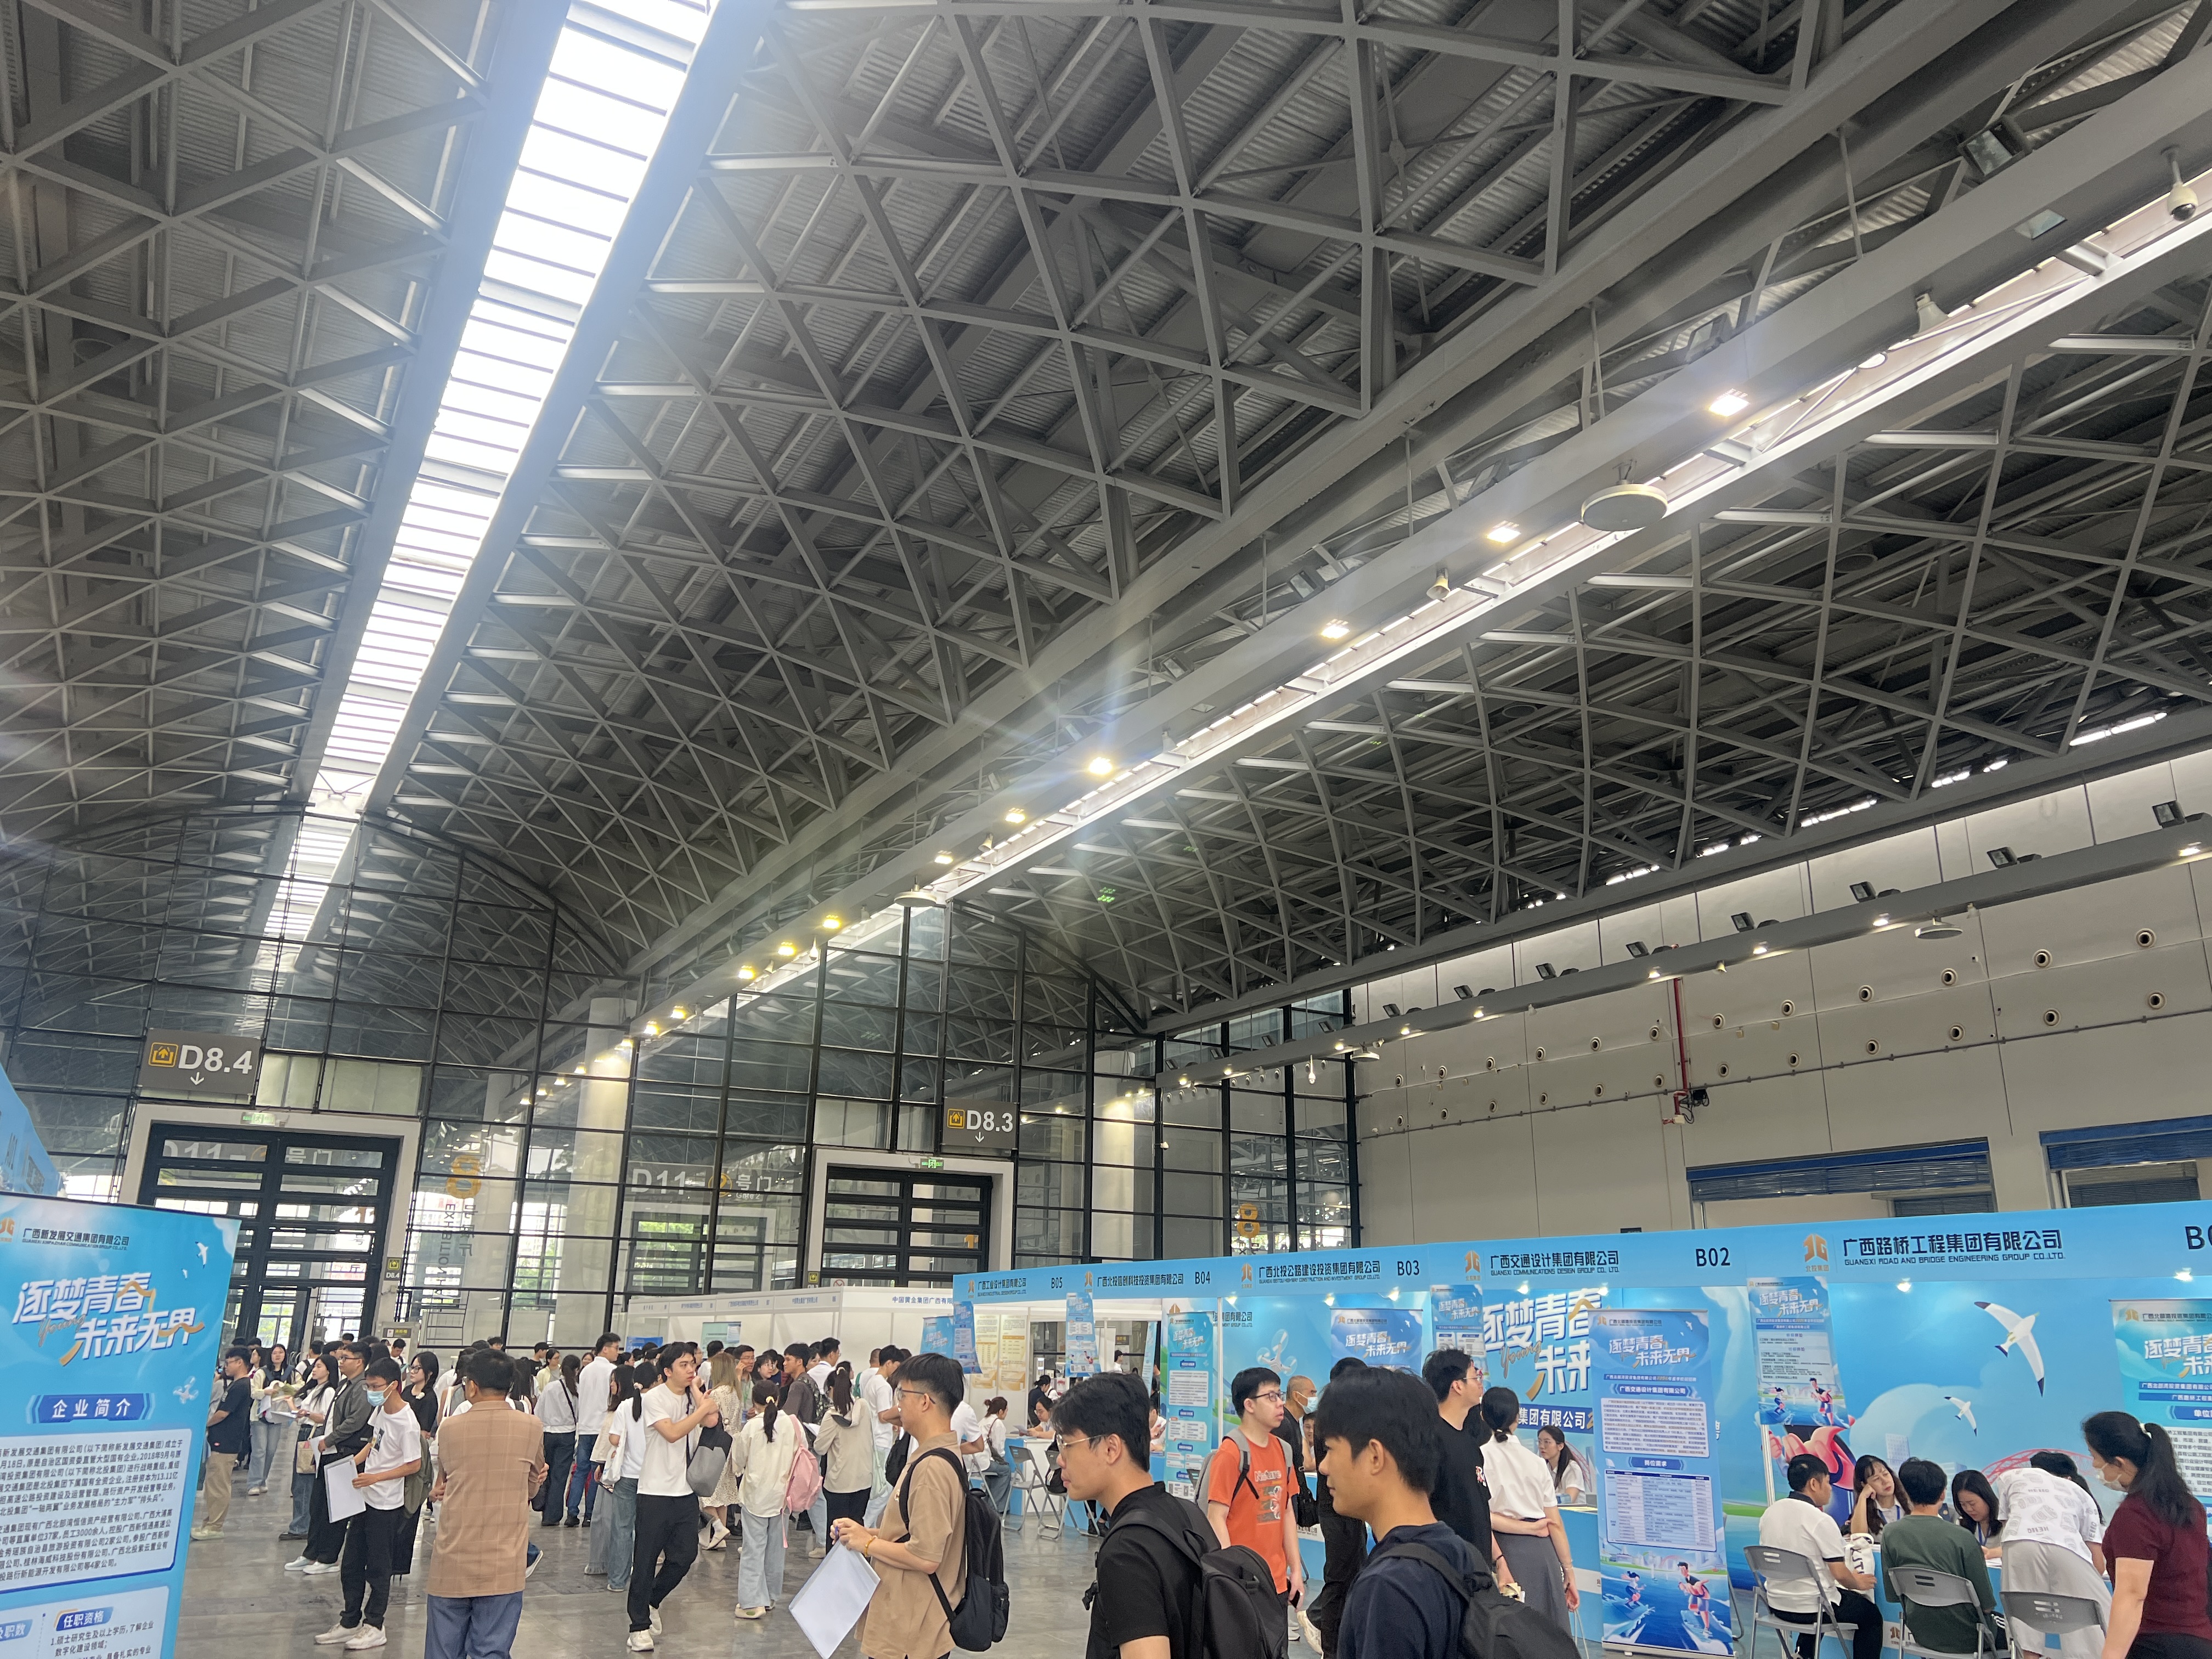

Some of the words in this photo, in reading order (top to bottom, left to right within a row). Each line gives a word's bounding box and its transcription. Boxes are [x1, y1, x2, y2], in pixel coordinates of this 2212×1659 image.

[178, 1045, 252, 1074] D8.4
[967, 1110, 1013, 1132] D8.3
[1237, 1203, 1260, 1238] 8
[23, 1228, 129, 1246] 广西新发展交通集团有限公司
[1843, 1229, 2063, 1256] 广西路桥工程集团有限公司
[2185, 1225, 2212, 1250] B
[1491, 1250, 1619, 1269] 广西交通设计集团有限公司
[1695, 1247, 1730, 1267] B02
[1948, 1254, 1999, 1262] ENGINEERING
[1195, 1271, 1211, 1285] B04
[1259, 1261, 1381, 1278] 广西北投公路建设投资集团有限公司
[1397, 1260, 1420, 1276] B03
[1051, 1277, 1063, 1289] B05
[12, 1273, 151, 1324] 逐梦青春
[1483, 1288, 1601, 1352] 逐梦青春
[74, 1308, 196, 1359] 未来无界
[1345, 1331, 1387, 1347] 逐梦青春
[1366, 1341, 1407, 1357] 未来无界
[1609, 1334, 1663, 1354] 逐梦青春
[1635, 1347, 1690, 1367] 未来无界
[52, 1397, 131, 1419] 企业简介
[64, 1610, 104, 1629] 任职资格
